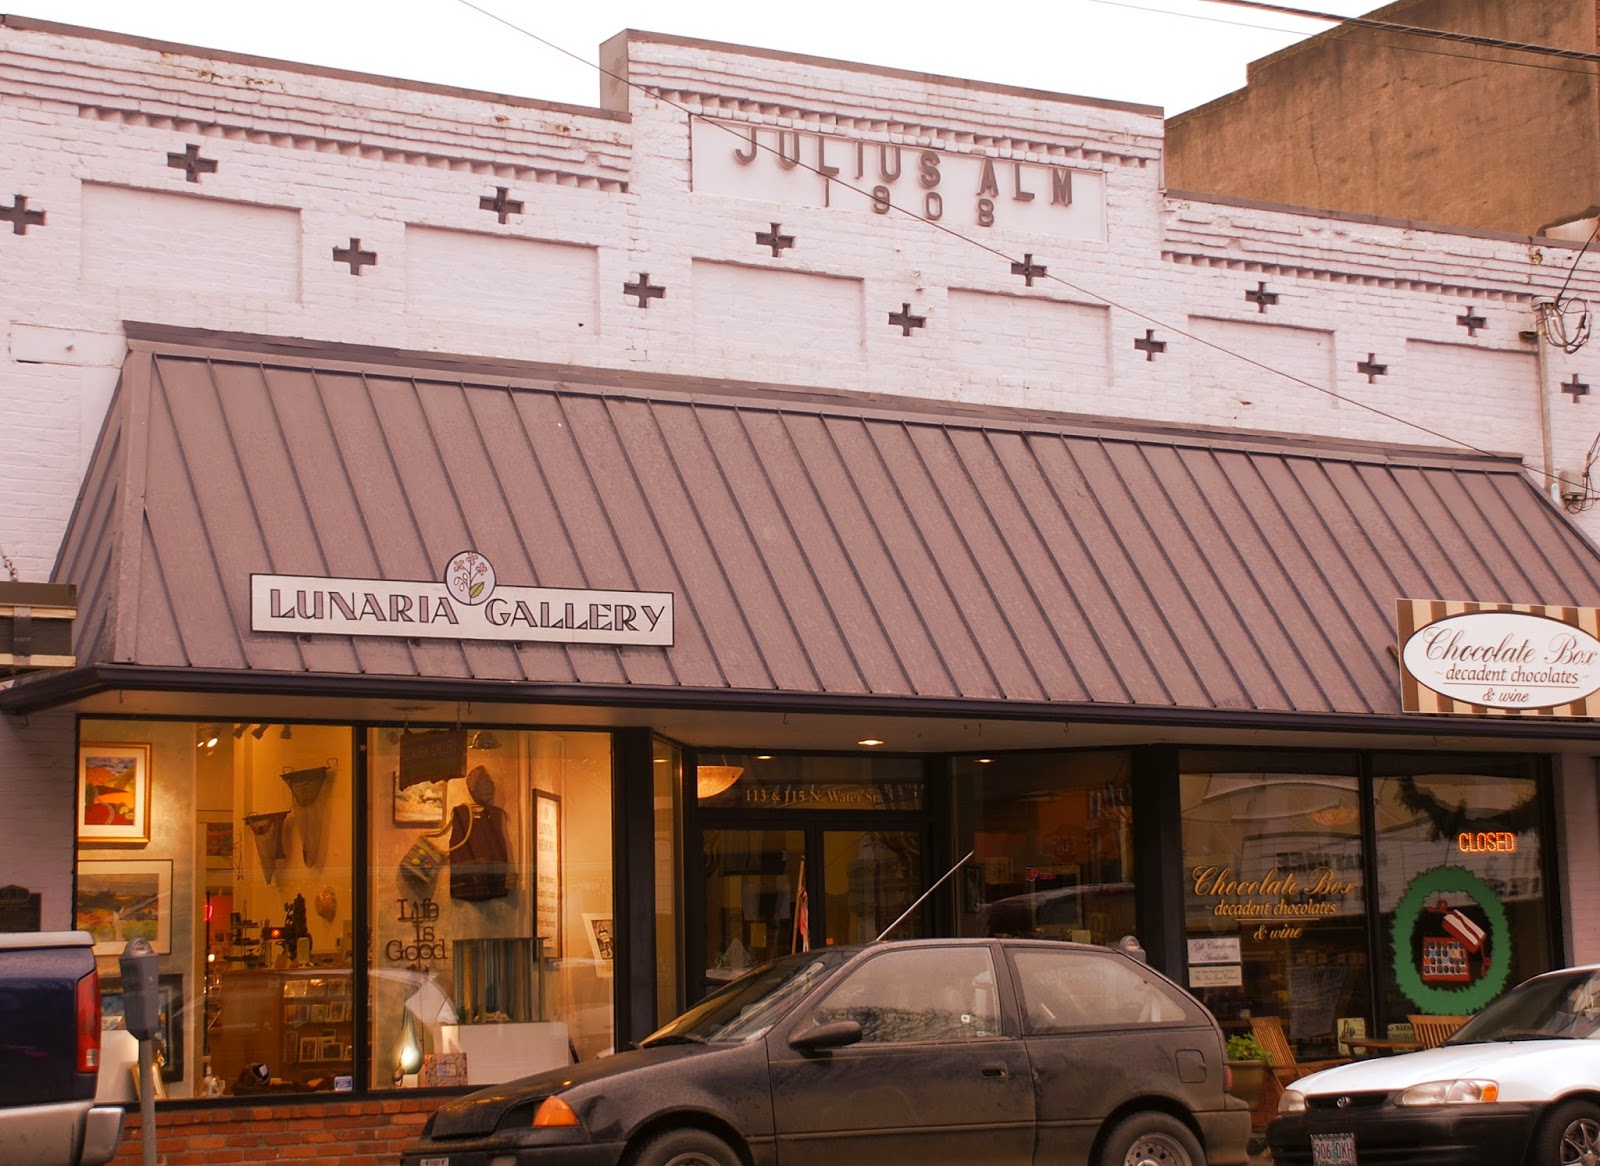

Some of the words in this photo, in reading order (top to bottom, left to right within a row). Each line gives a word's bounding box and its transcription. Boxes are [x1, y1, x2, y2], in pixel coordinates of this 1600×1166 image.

[735, 126, 940, 190] JULIUS
[976, 155, 1073, 207] ALM
[824, 178, 996, 227] 1908
[269, 588, 459, 626] LUNARIA
[484, 598, 666, 633] GALLERY
[1422, 626, 1536, 663] Chocolate
[1544, 632, 1598, 666] Box
[1445, 663, 1507, 682] decadent
[1510, 666, 1579, 684] chocolates
[1482, 688, 1494, 702] &
[1499, 689, 1529, 703] wine
[826, 790, 863, 803] Water
[1458, 832, 1516, 852] CLOSED
[1192, 865, 1299, 896] Chocolate
[1304, 866, 1355, 896] Box
[1214, 899, 1270, 916] decadent
[1273, 899, 1337, 916] chocolates
[1253, 925, 1268, 940] &
[1270, 924, 1302, 940] wine
[386, 939, 448, 961] Good
[1315, 1142, 1332, 1159] 906
